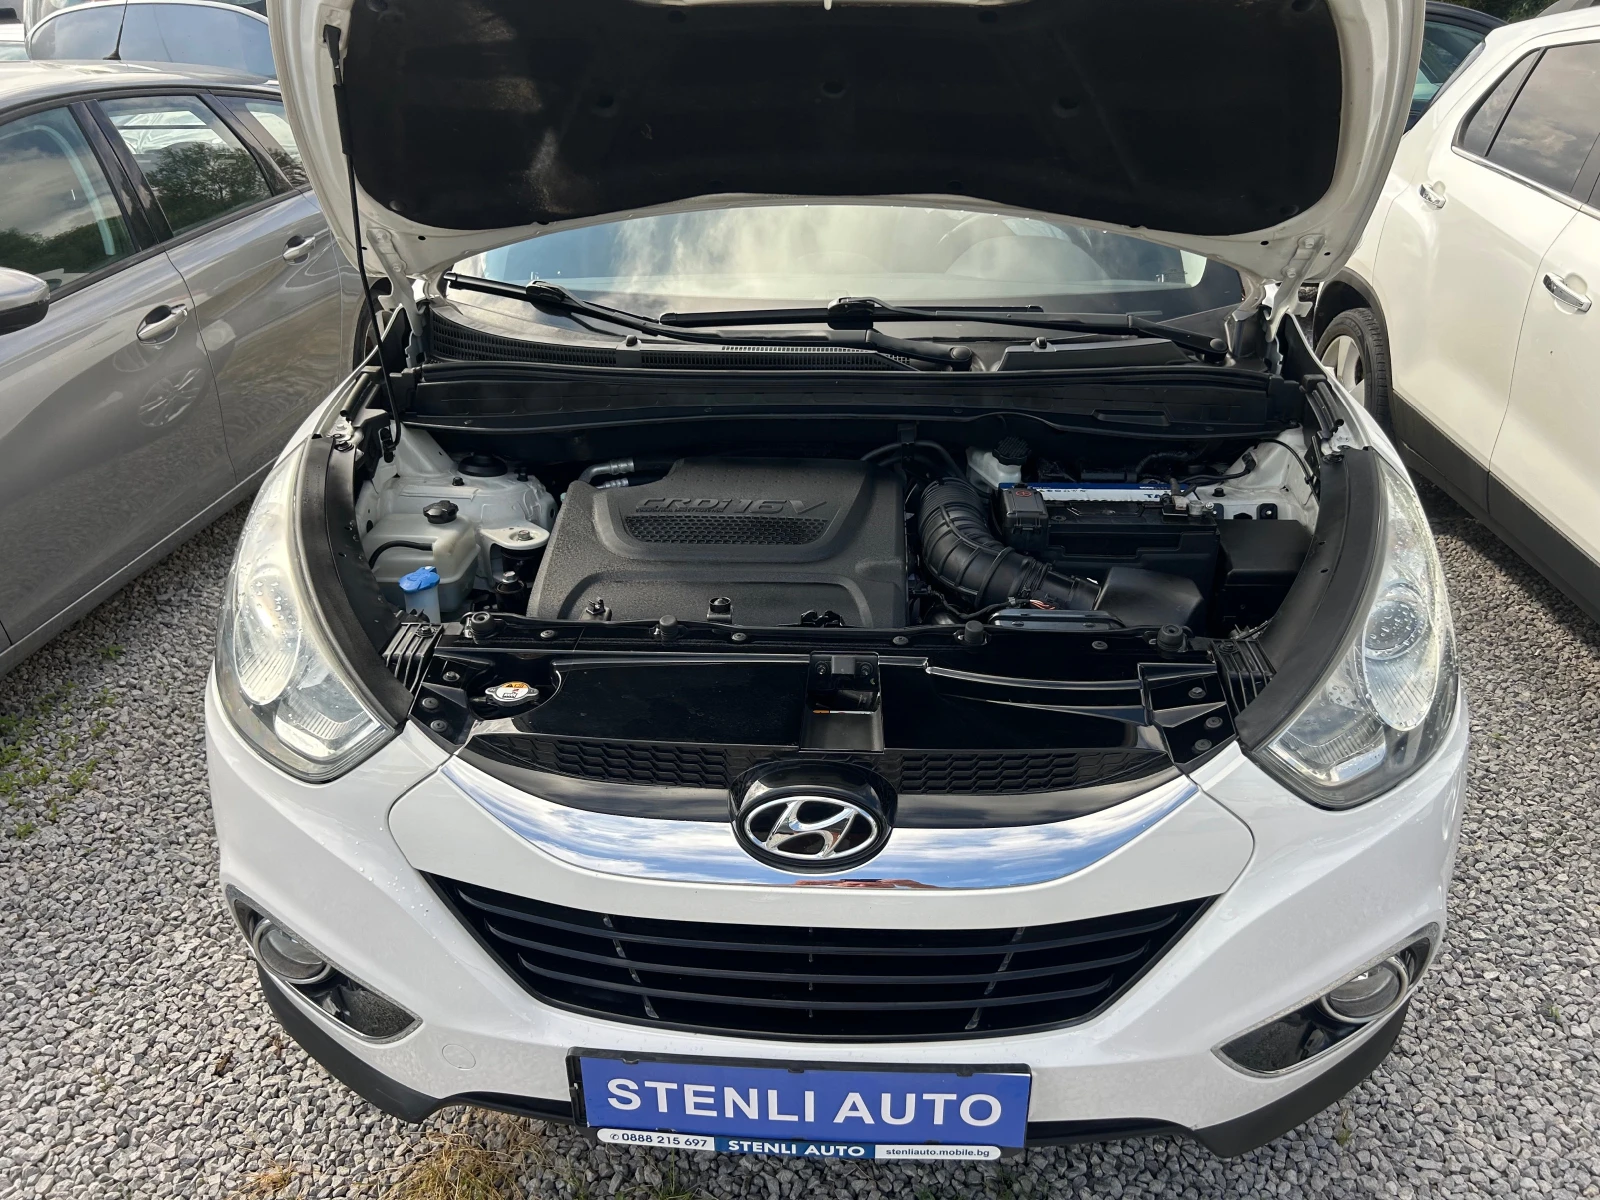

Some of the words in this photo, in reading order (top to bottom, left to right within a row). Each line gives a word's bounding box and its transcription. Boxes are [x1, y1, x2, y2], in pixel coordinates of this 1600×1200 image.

[607, 1078, 814, 1122] STENLI
[833, 1092, 1001, 1127] AUTO
[621, 1132, 653, 1143] 0888
[657, 1136, 681, 1146] 215
[684, 1139, 707, 1148] 697
[728, 1140, 796, 1154] STENLI
[804, 1145, 865, 1156] AUTO
[885, 1148, 990, 1158] stenliauto.mobile.bg
